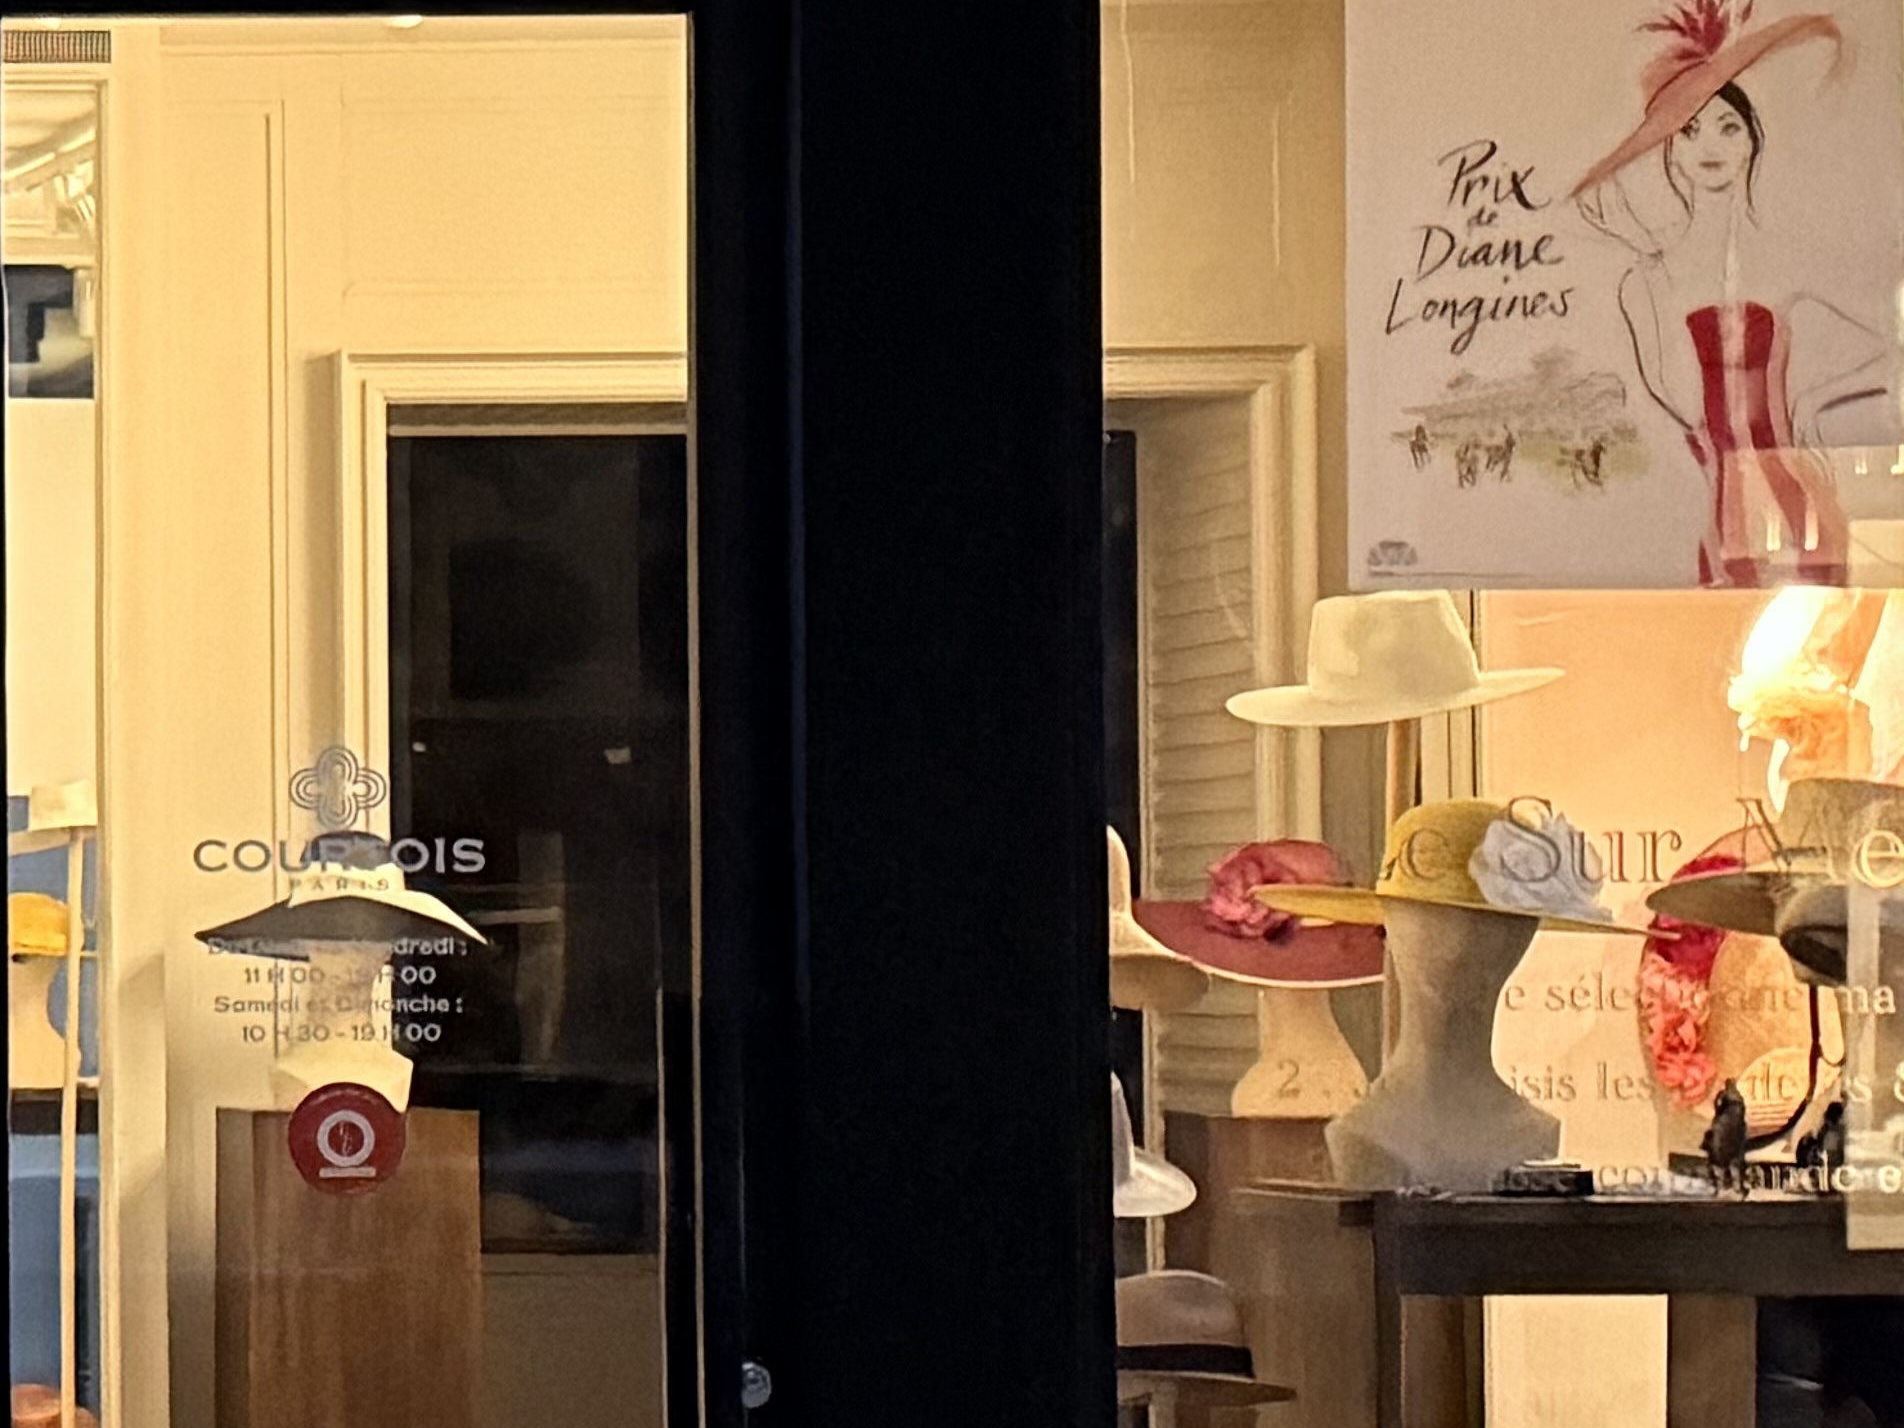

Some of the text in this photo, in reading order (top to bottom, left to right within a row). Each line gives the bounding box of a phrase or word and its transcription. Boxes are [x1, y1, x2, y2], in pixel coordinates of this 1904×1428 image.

[1437, 139, 1552, 211] Prix
[1466, 208, 1498, 228] de
[1413, 224, 1565, 282] Diane
[1385, 273, 1576, 355] Longines
[193, 837, 486, 873] COUROIS
[1501, 795, 1682, 883] Sur
[213, 996, 300, 1013] Samedi
[242, 1025, 266, 1042] 10
[297, 1024, 331, 1042] 30
[404, 1023, 441, 1042] 00
[1597, 1060, 1657, 1102] les
